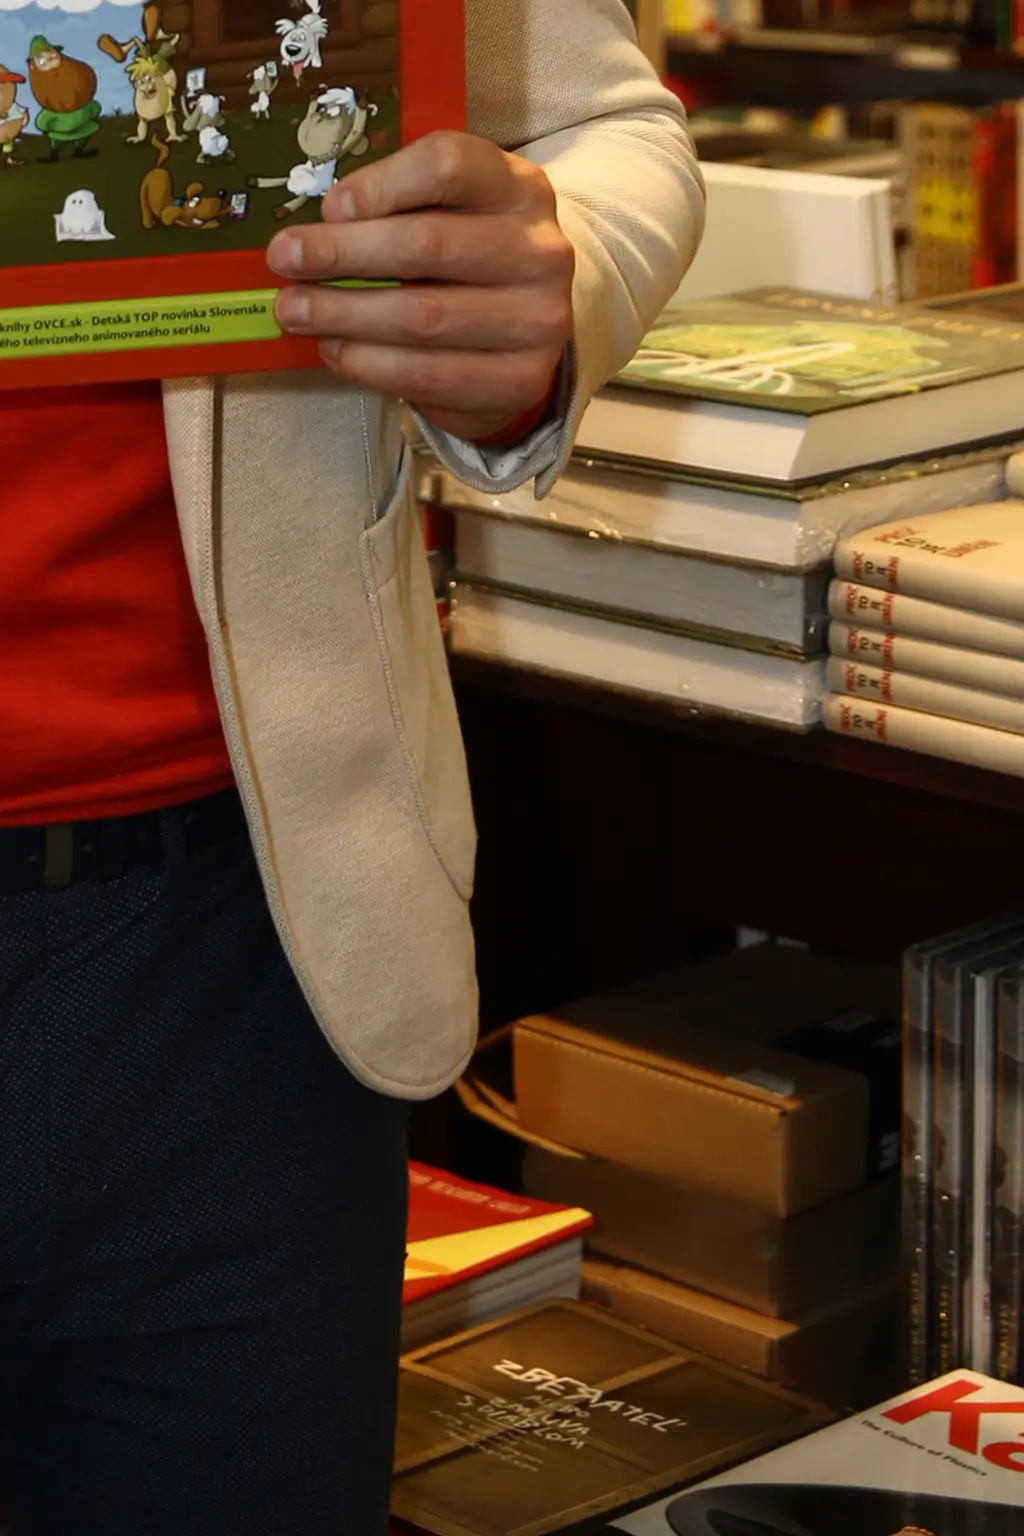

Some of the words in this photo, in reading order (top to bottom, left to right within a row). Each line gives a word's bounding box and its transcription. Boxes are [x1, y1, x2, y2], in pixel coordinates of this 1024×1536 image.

[0, 321, 31, 335] knihy
[33, 317, 82, 330] OVCE.sk
[91, 311, 131, 326] Detská
[134, 311, 159, 323] TOP
[161, 307, 207, 321] novinka
[209, 303, 267, 317] Slovenska
[23, 332, 90, 347] televízneho
[92, 325, 170, 342] animovaného
[172, 323, 211, 336] seriálu
[862, 1419, 882, 1431] The
[883, 1429, 925, 1450] Culture
[942, 1453, 988, 1476] Plastics
